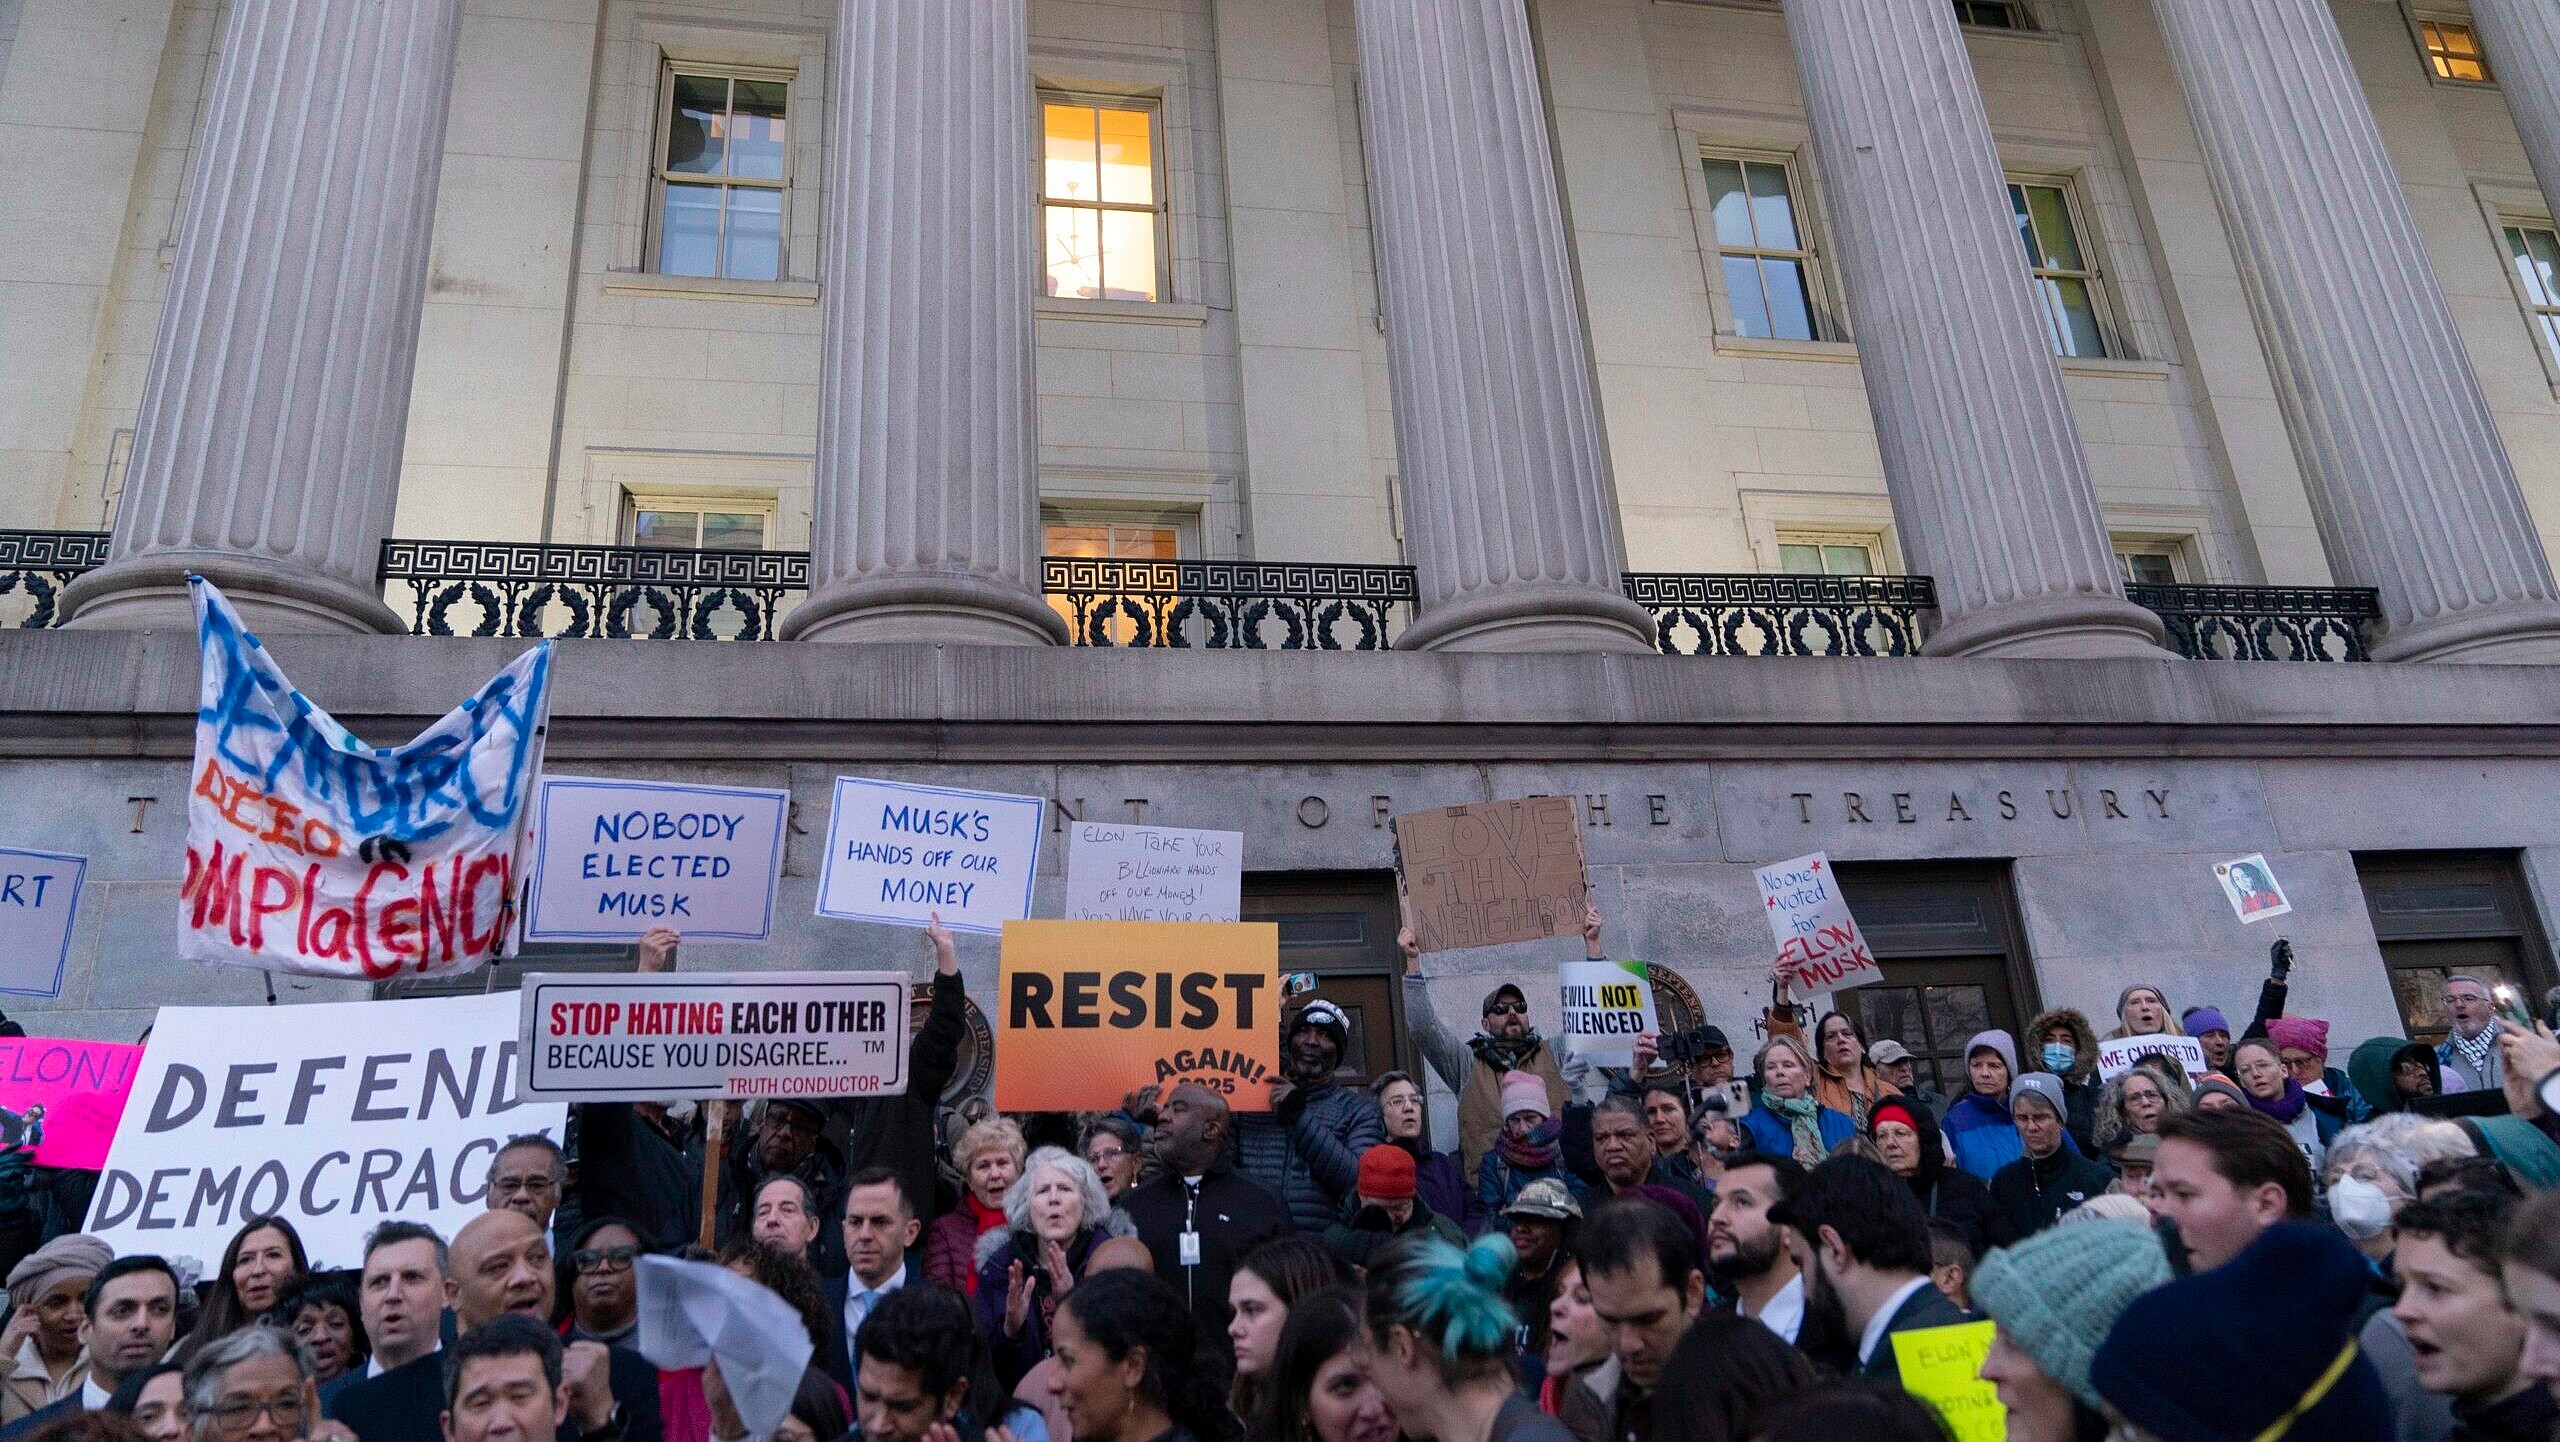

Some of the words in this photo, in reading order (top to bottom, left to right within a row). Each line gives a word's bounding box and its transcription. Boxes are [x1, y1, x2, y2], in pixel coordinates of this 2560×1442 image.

[881, 804, 989, 842] MUSK'S
[1298, 795, 1391, 828] OF
[1790, 789, 2170, 824] TREASURY
[594, 810, 744, 845] NOBODY
[1083, 826, 1125, 843] ELON
[1192, 833, 1225, 858] YOUR
[1404, 800, 1575, 865] LOVE
[582, 853, 730, 880] ELECTED
[847, 840, 913, 865] HANDS
[922, 850, 954, 867] OFF
[960, 854, 998, 875] OUR
[881, 877, 975, 908] MONEY
[1127, 887, 1152, 898] OUR
[1426, 856, 1540, 905] THY
[1776, 879, 1827, 911] voted
[598, 891, 691, 917] MUSK
[1419, 882, 1588, 950] NEIGHBOR
[1791, 913, 1820, 934] for
[1782, 920, 1854, 966] ELON
[1799, 944, 1877, 989] MUSK
[1009, 971, 1265, 1030] RESIST
[1568, 985, 1597, 1008] WILL
[1601, 985, 1637, 1008] NOT
[550, 1003, 620, 1036] STOP
[627, 1002, 723, 1035] HATING
[731, 1001, 797, 1034] EACH
[805, 1000, 886, 1033] OTHER
[1567, 1011, 1644, 1035] SILENCED
[548, 1044, 655, 1069] BECAUSE
[664, 1043, 707, 1068] YOU
[716, 1041, 848, 1067] DISAGREE...
[1155, 1048, 1266, 1085] AGAIN!
[2101, 1049, 2125, 1069] WE
[2183, 1045, 2199, 1062] TO
[729, 1077, 777, 1094] TRUTH
[782, 1076, 880, 1094] CONDUCTOR
[1178, 1078, 1235, 1094] 25
[91, 1127, 551, 1232] DEMOCRAC
